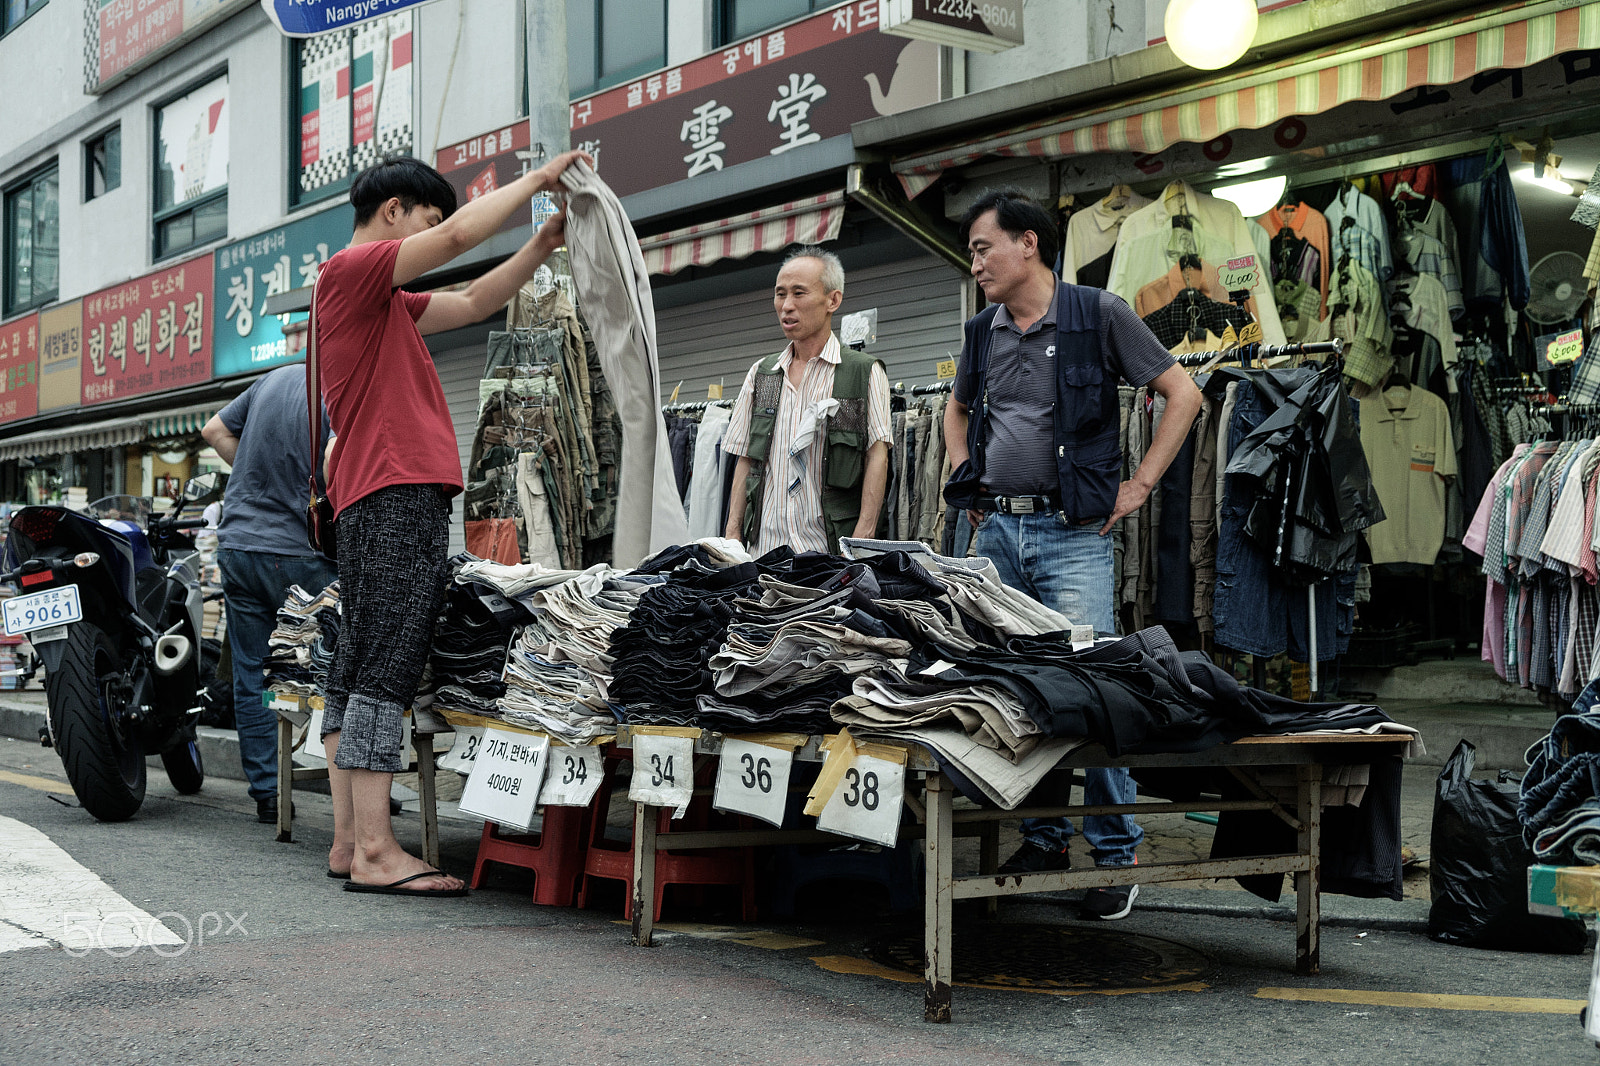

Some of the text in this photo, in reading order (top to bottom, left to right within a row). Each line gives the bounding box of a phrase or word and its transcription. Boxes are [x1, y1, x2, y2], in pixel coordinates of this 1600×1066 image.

[455, 127, 513, 166] 고미술품
[626, 67, 682, 109] 골동품
[722, 31, 785, 74] 공예품
[43, 326, 79, 359] 세방빌딩
[87, 292, 204, 376] 헌책백화점
[11, 601, 72, 627] 사 9061
[487, 773, 522, 796] 4000원
[563, 755, 588, 786] 34
[651, 753, 675, 788] 34
[740, 753, 772, 794] 36
[843, 767, 879, 811] 38
